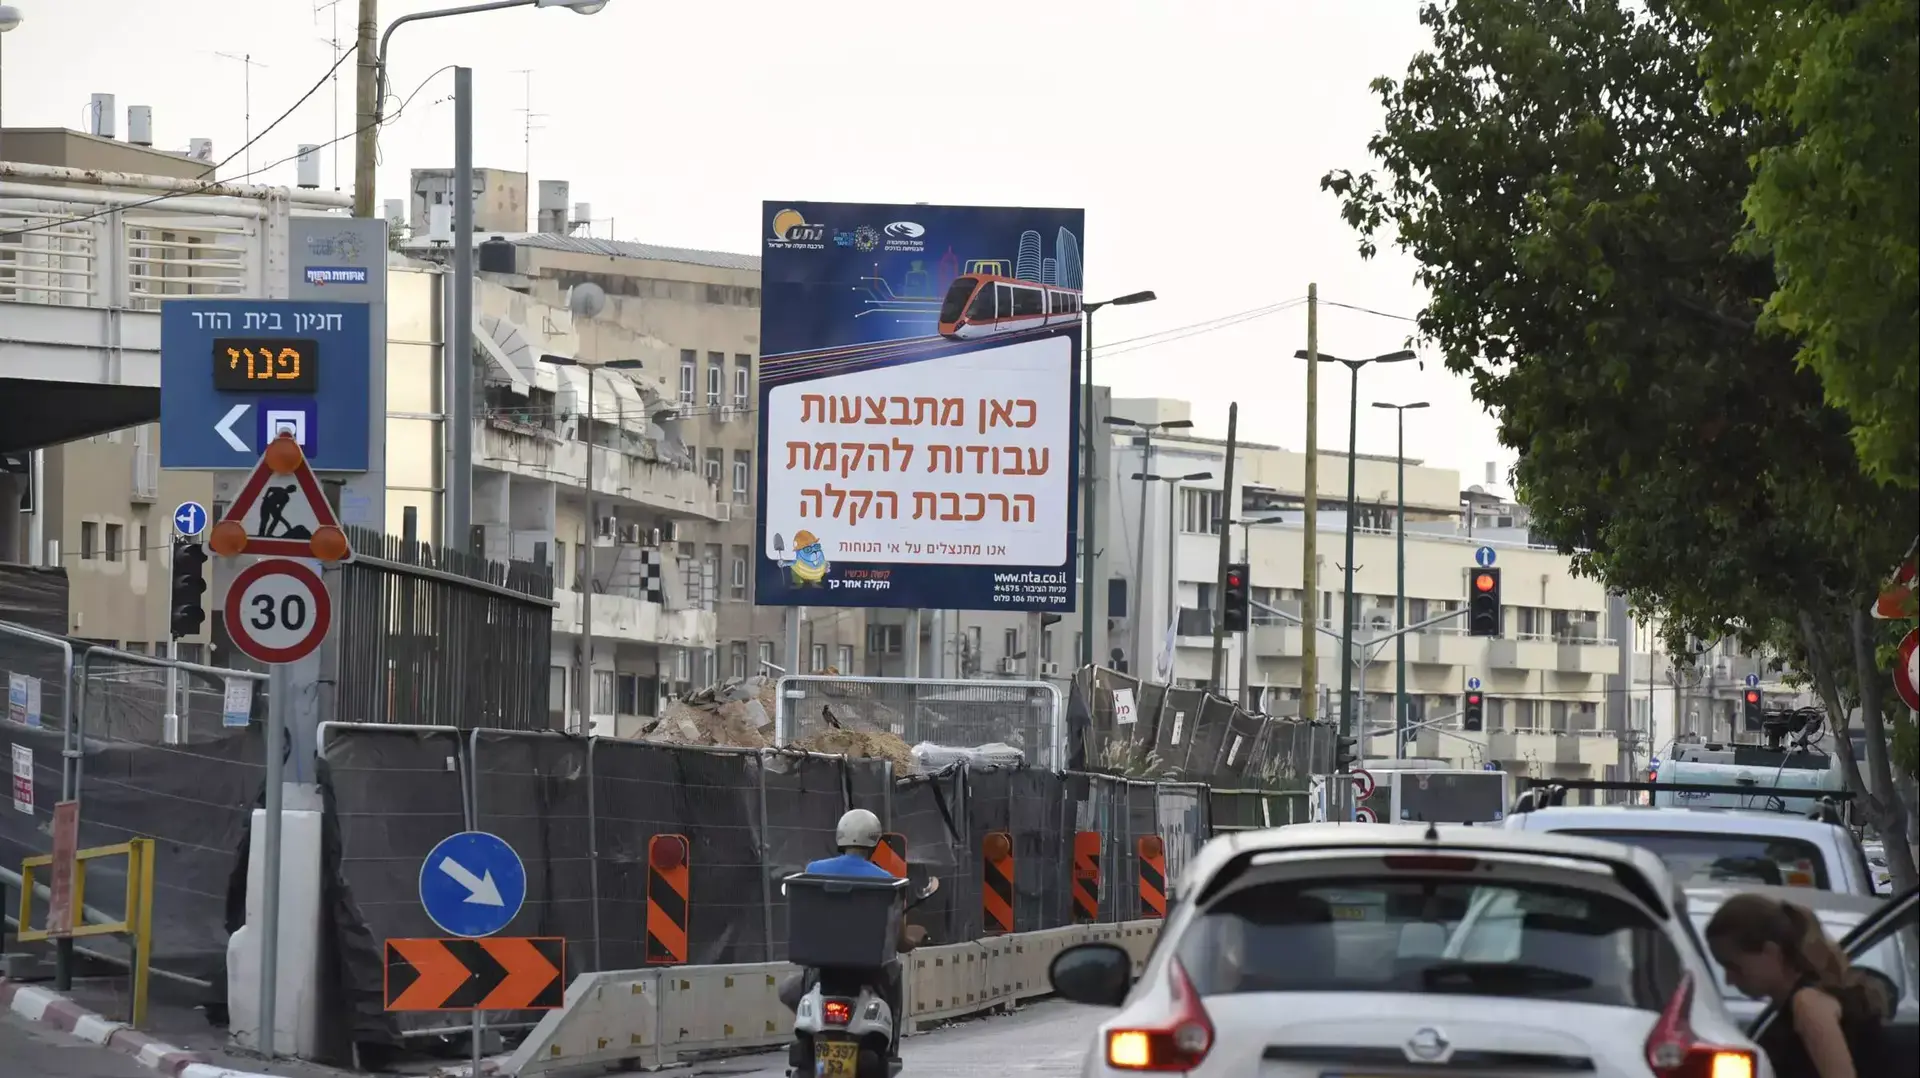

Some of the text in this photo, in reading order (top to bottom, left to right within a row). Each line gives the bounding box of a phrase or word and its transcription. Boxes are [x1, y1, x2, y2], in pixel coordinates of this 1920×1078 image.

[192, 312, 342, 332] חניון בית הדר
[227, 347, 300, 379] פנוי
[800, 394, 1037, 434] כאן מתבצעות
[786, 437, 1049, 479] עבודות להקמת
[800, 483, 1035, 526] הרכבת הקלה
[838, 541, 1006, 556] אנו מתנצלים על אי הנוחות
[844, 569, 868, 578] עכשיו
[994, 571, 1067, 584] www.nta.co.il
[828, 579, 890, 591] הקלה אחר כך
[1048, 585, 1067, 593] פניות
[993, 594, 1010, 602] פלוס
[1050, 596, 1067, 604] מוקד
[250, 594, 306, 630] 30
